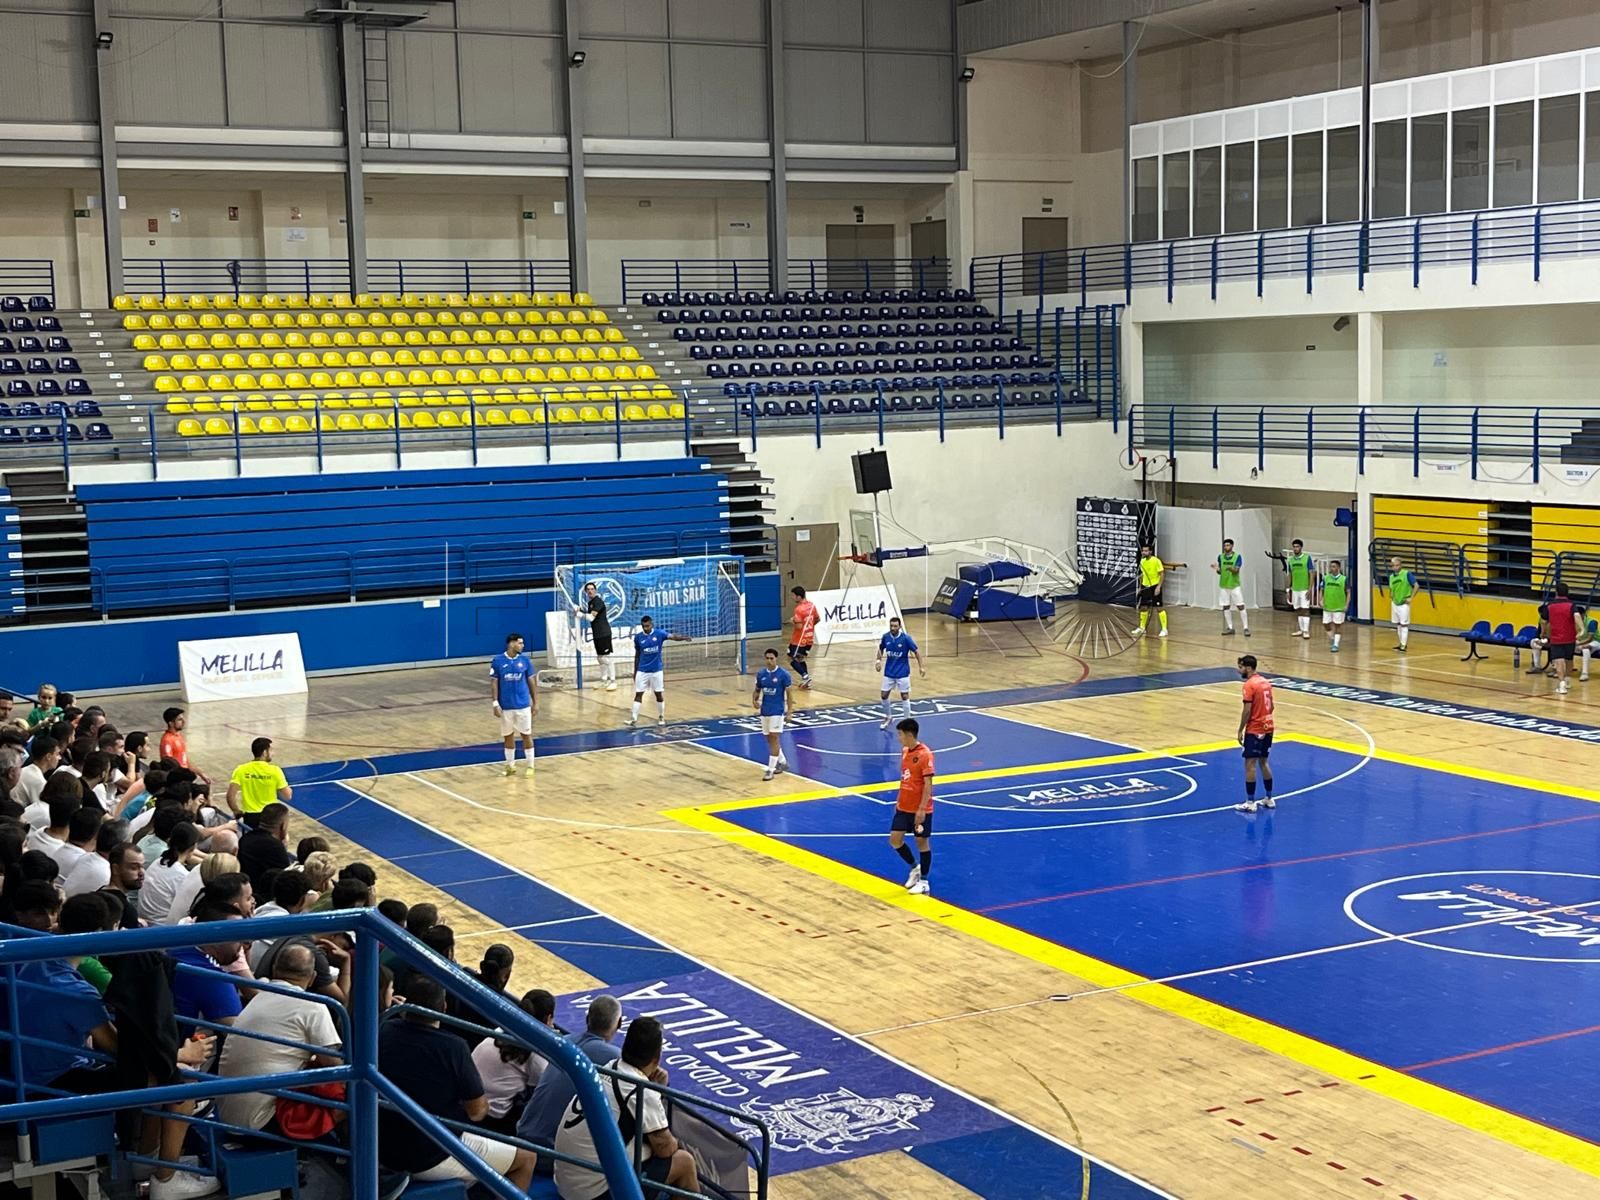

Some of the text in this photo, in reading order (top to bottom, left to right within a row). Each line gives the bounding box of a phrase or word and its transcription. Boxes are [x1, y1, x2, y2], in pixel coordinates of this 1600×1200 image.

[682, 585, 706, 604] SALA
[824, 600, 887, 623] MELILLA
[201, 649, 283, 676] MELILLA
[1263, 690, 1271, 711] 5
[1008, 778, 1154, 803] MELILLA
[616, 980, 830, 1088] MELILLA
[665, 1053, 750, 1097] CIUDAD
[740, 1069, 764, 1080] DE
